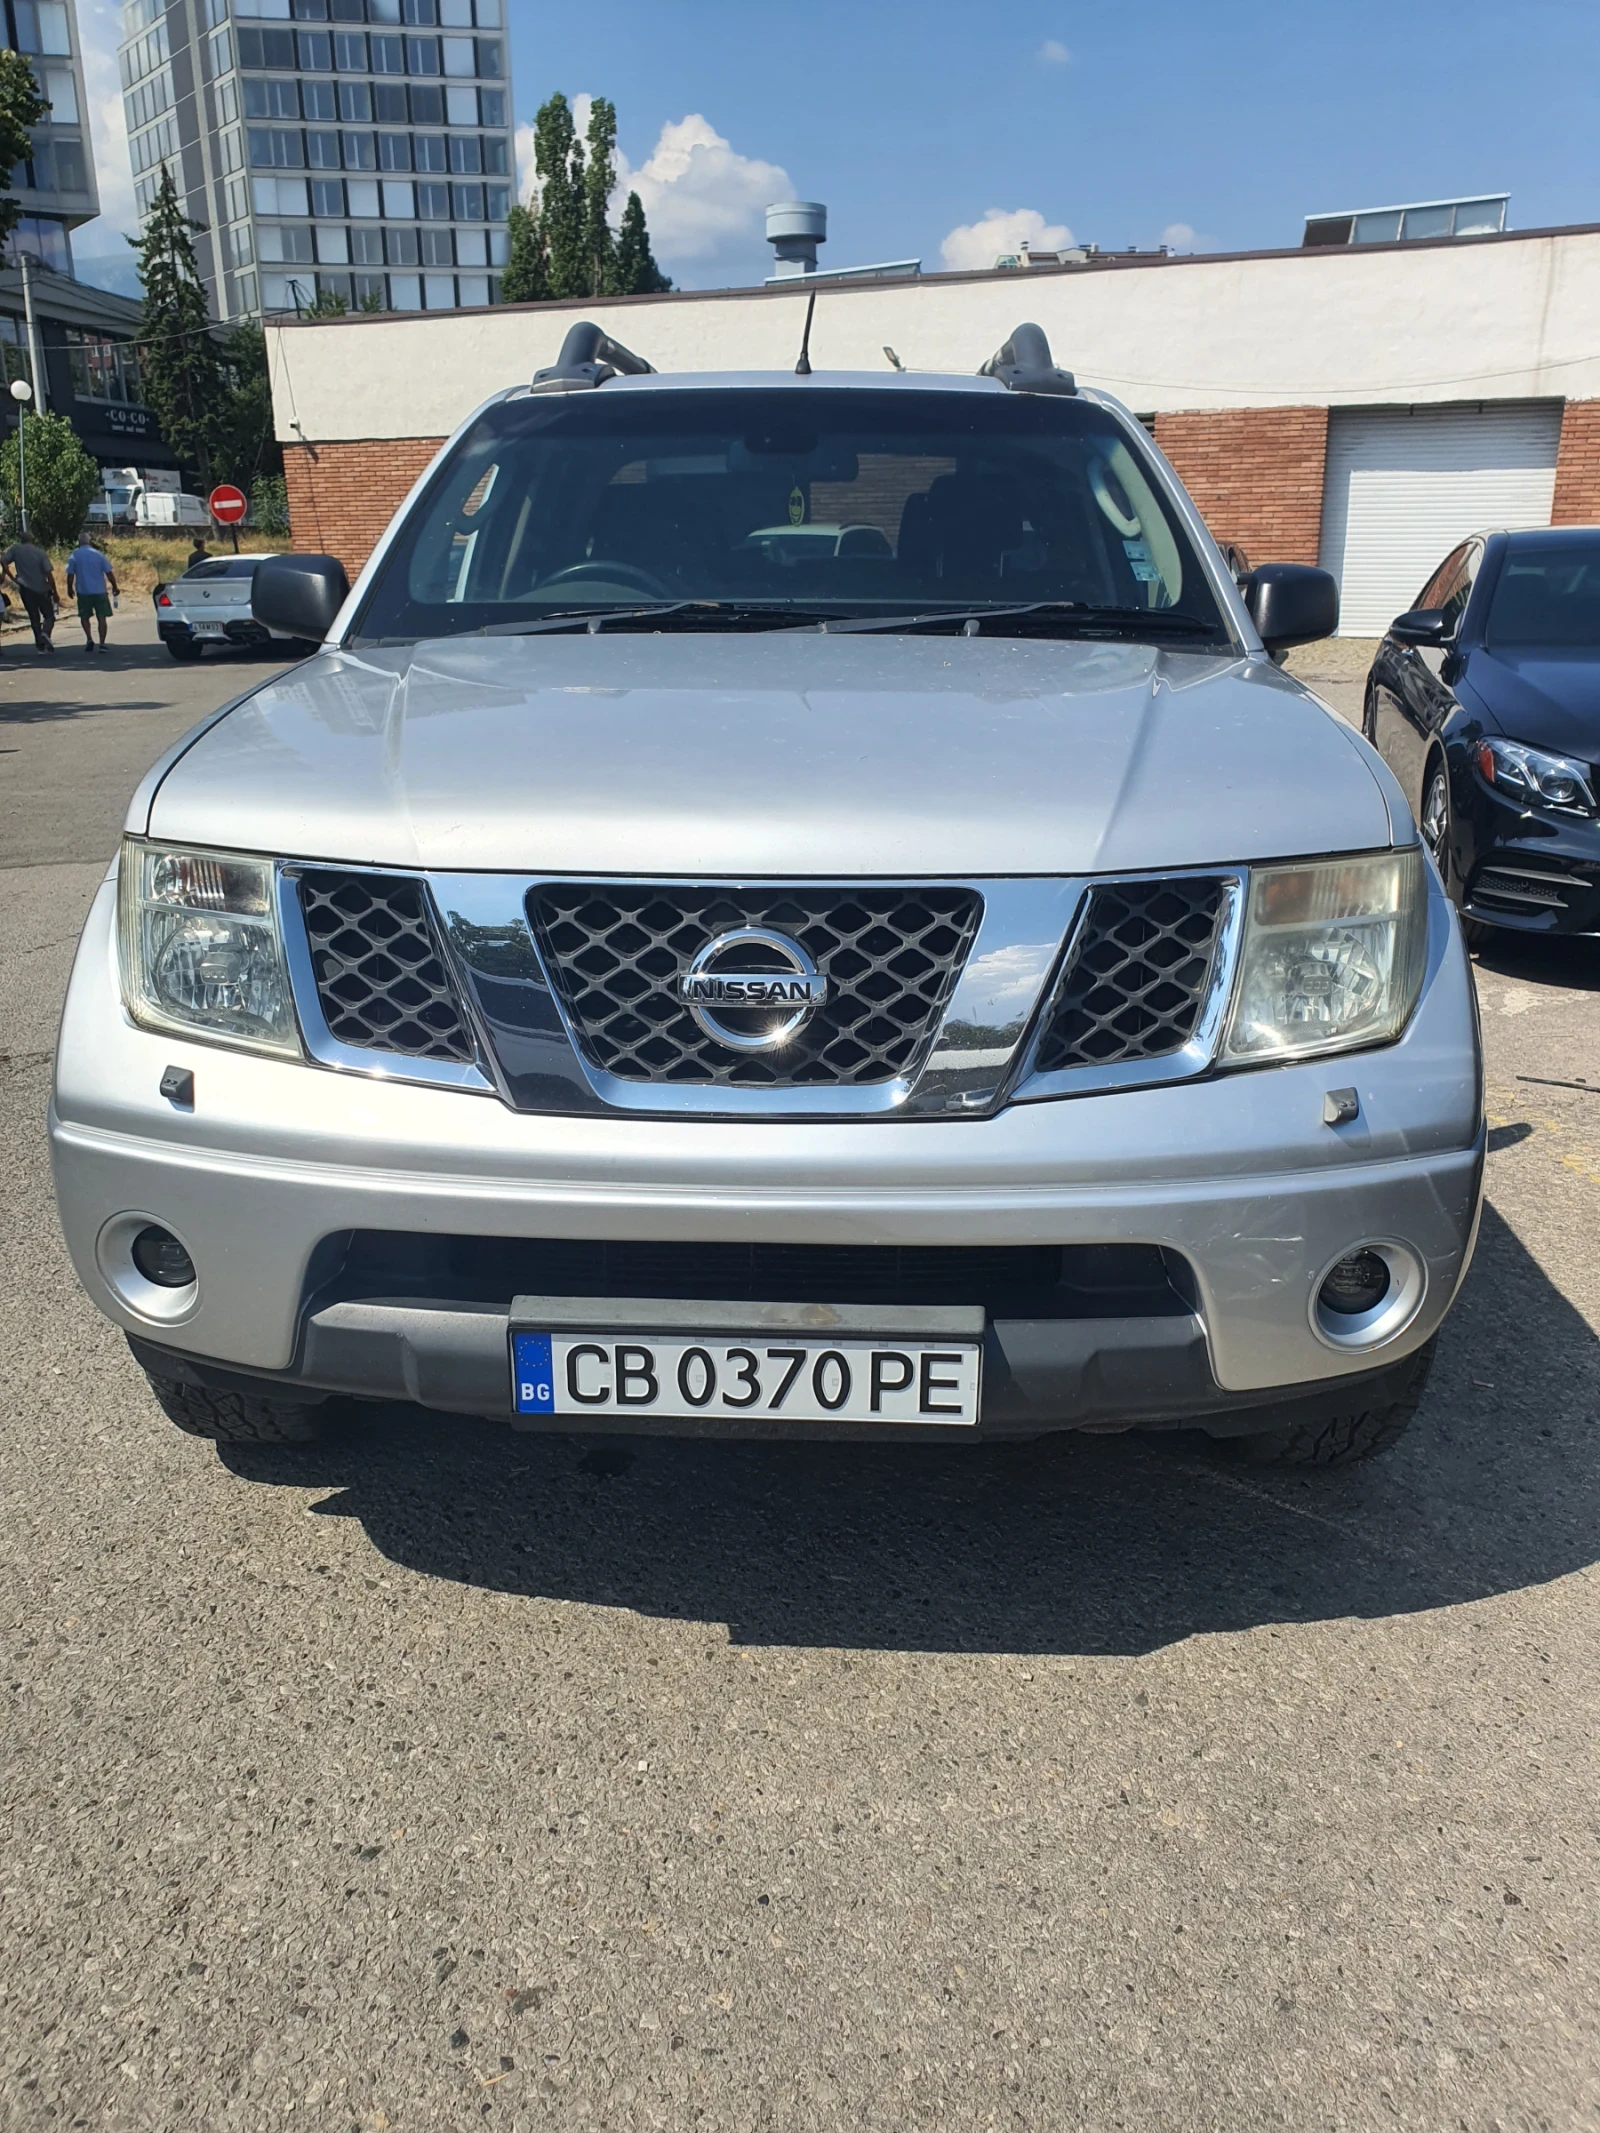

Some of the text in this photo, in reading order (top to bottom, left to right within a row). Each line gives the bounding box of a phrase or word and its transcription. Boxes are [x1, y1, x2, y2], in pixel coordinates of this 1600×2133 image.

[693, 981, 811, 1000] NISSAN
[566, 1344, 962, 1413] CB 0370 PE
[521, 1383, 550, 1400] BG
